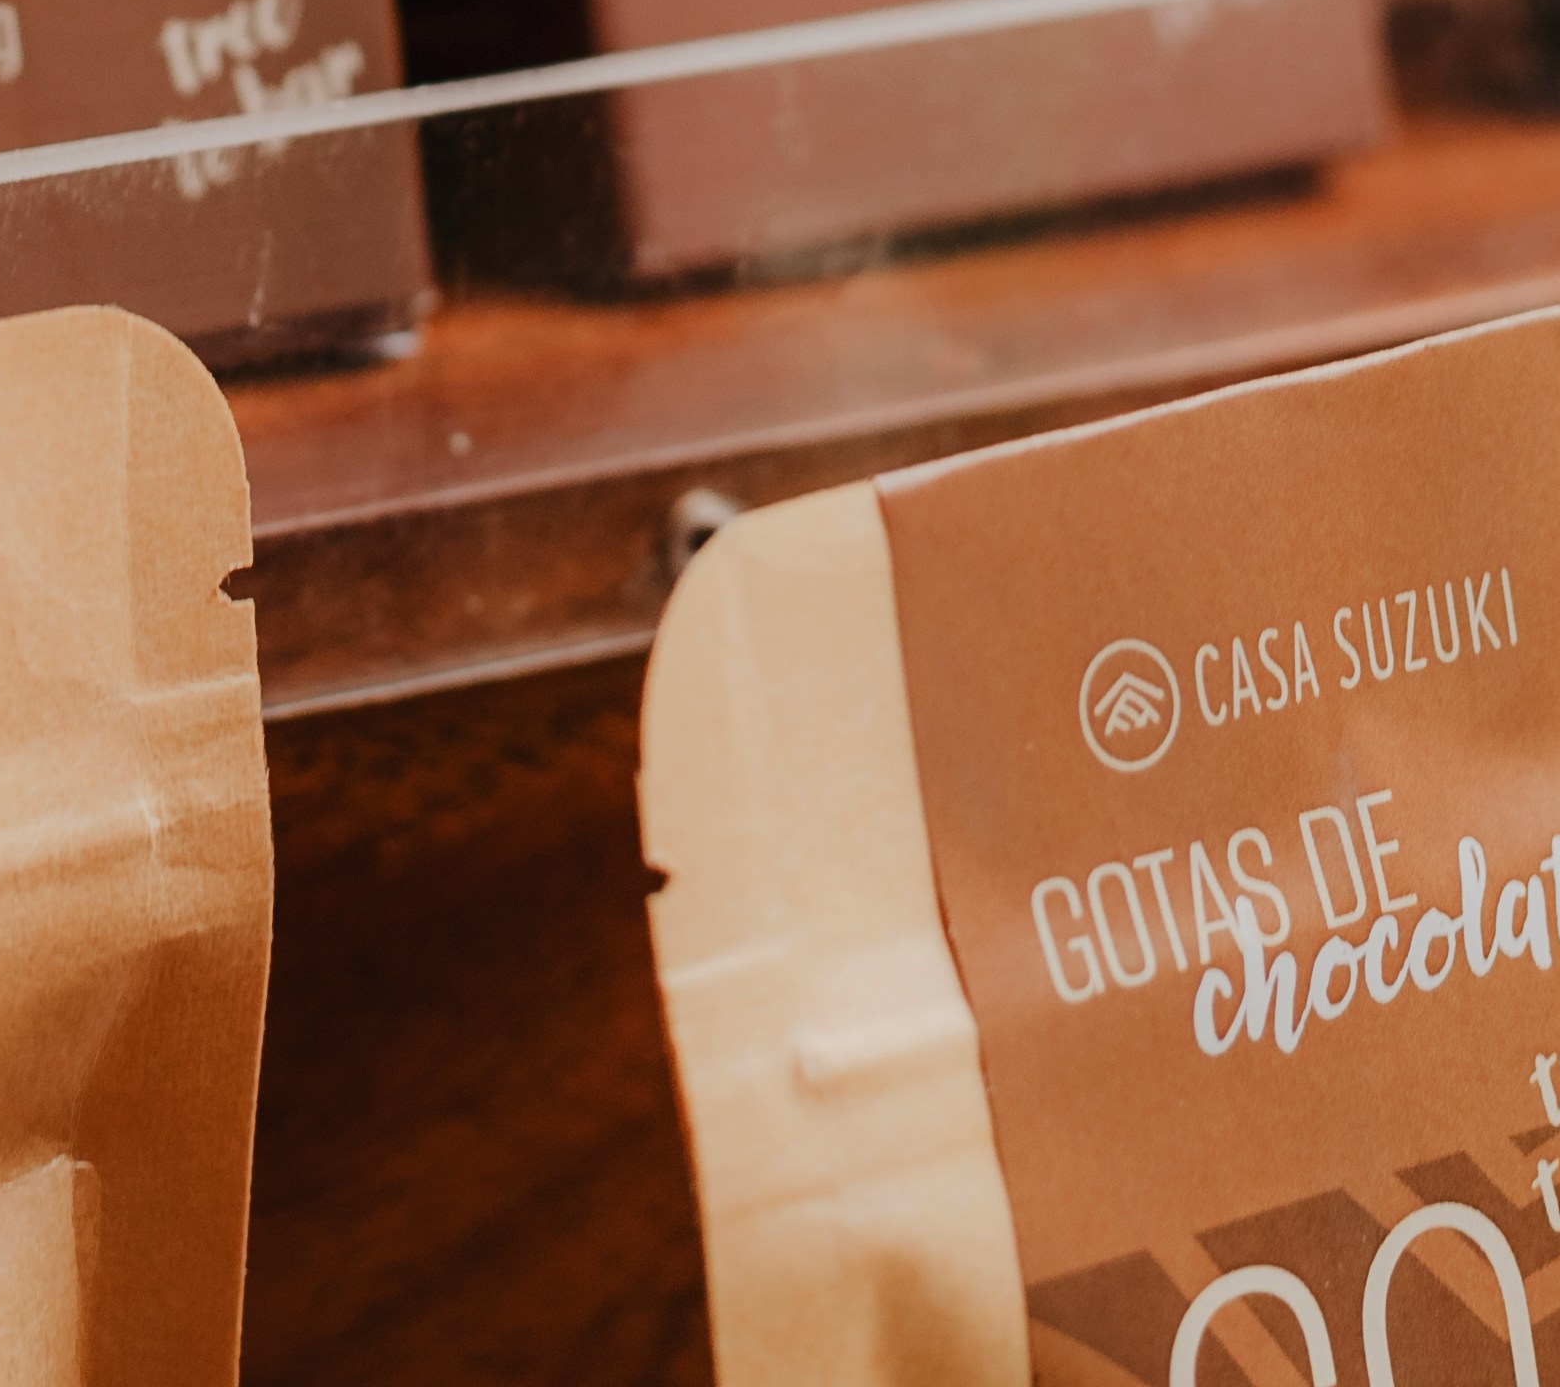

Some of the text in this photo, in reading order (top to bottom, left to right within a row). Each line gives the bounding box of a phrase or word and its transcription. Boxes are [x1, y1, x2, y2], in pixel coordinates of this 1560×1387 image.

[1194, 566, 1518, 728] CASA SUZUKI
[1031, 789, 1417, 1004] GOTAS DE
